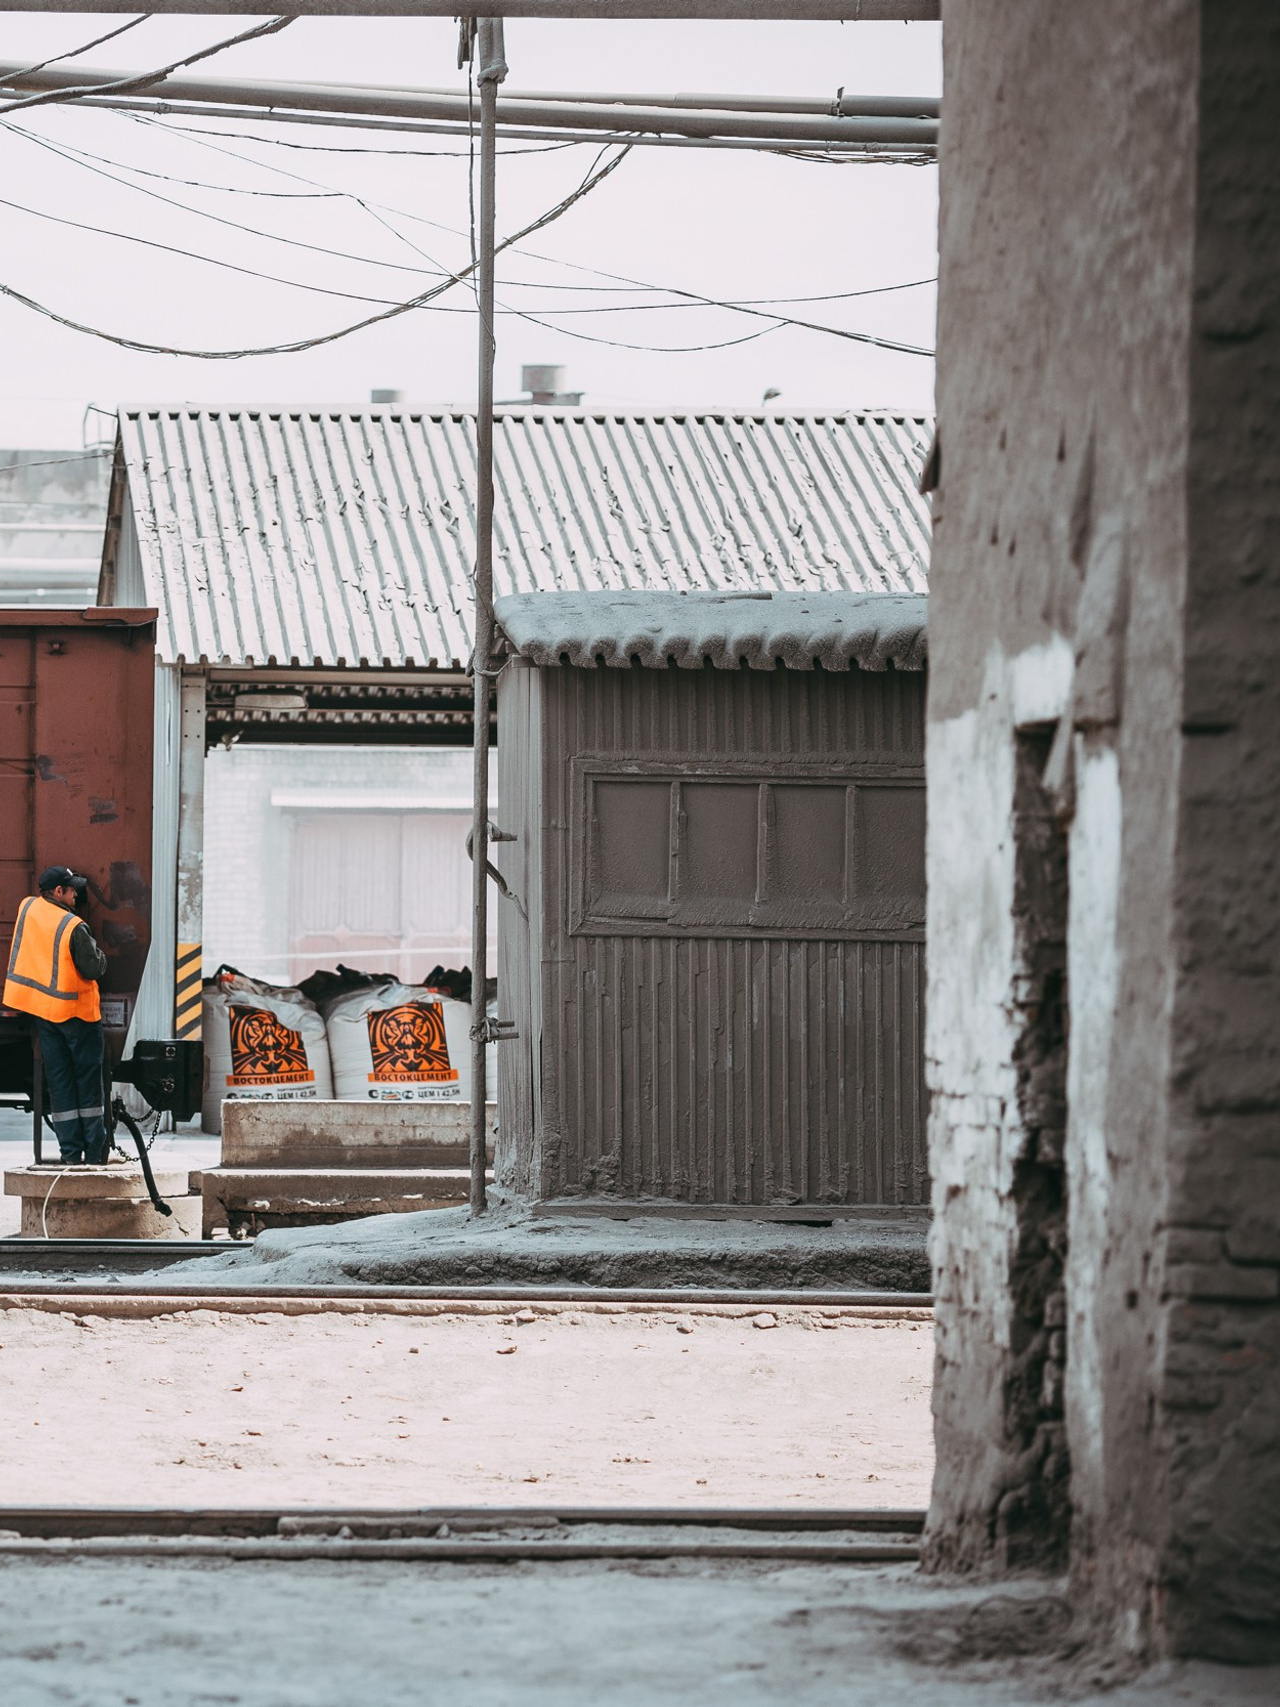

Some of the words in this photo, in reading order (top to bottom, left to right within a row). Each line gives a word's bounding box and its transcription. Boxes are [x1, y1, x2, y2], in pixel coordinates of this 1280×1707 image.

[233, 1073, 309, 1085] ВОСТОКЦЕМЕНТ
[374, 1072, 452, 1082] ВОСТОКЦЕМЕНТ
[418, 1090, 435, 1098] ЦЕМ
